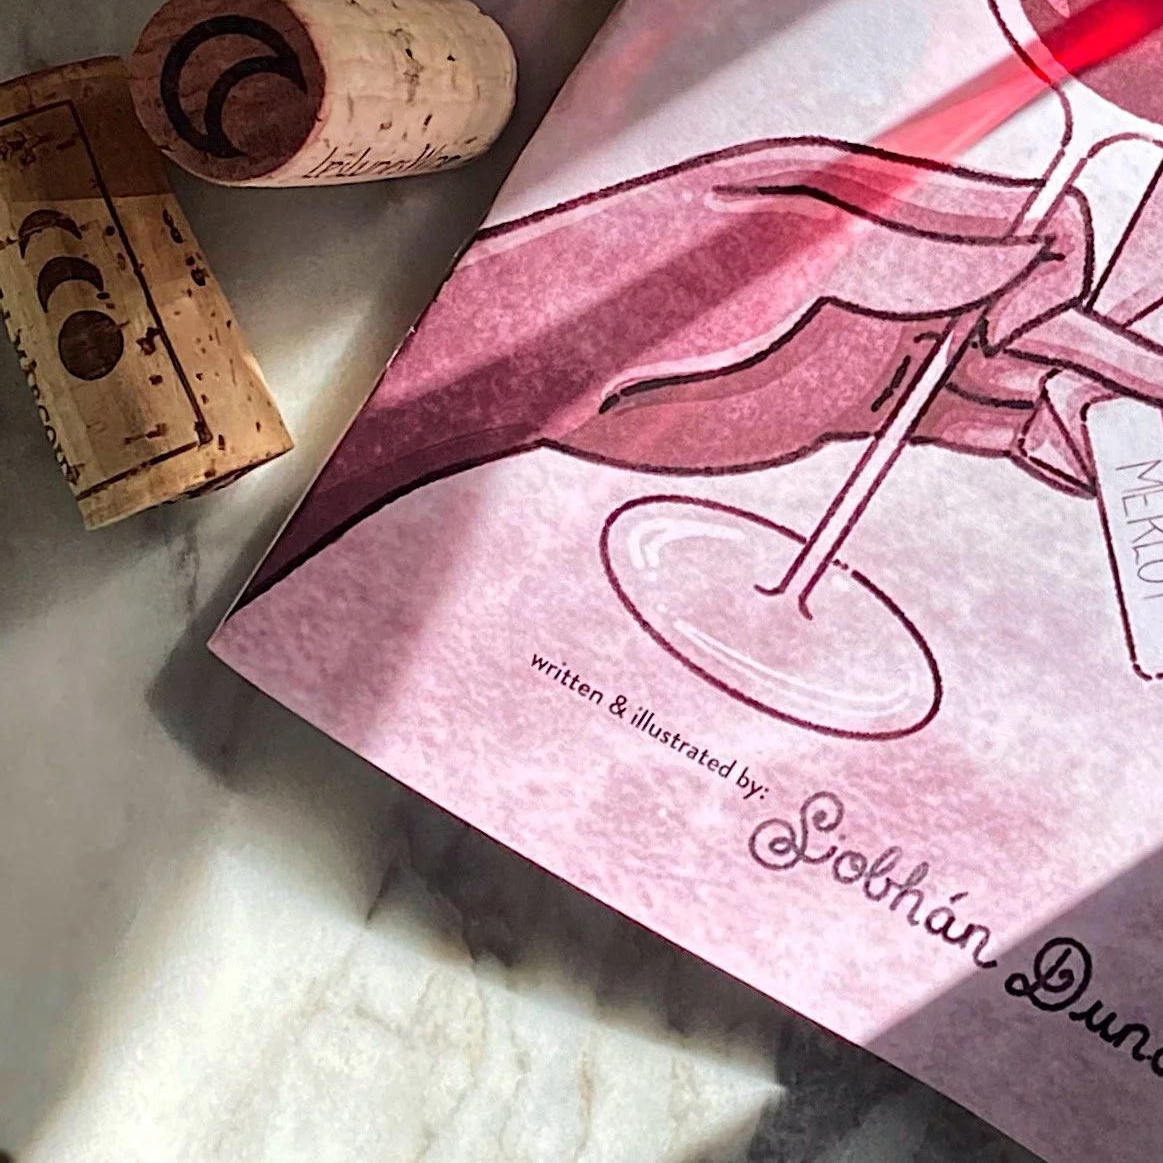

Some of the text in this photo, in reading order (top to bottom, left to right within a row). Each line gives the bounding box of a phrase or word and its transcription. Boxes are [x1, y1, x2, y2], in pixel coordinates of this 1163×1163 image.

[530, 653, 770, 800] written & illustrated by:
[748, 791, 998, 969] Siobhán
